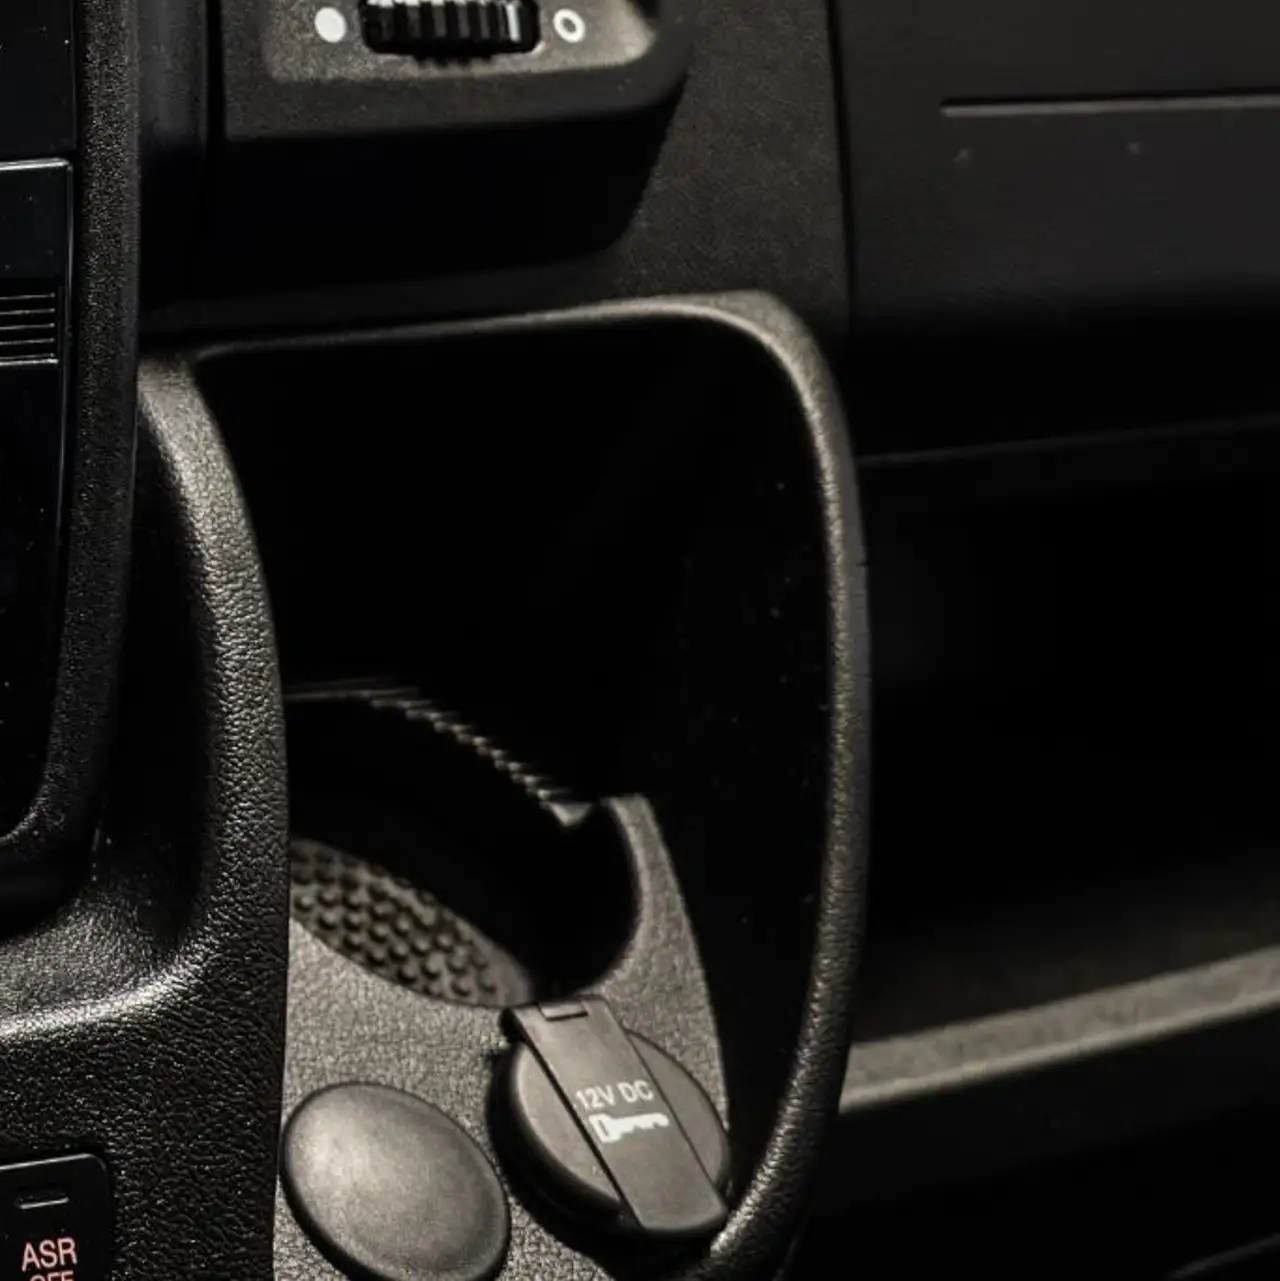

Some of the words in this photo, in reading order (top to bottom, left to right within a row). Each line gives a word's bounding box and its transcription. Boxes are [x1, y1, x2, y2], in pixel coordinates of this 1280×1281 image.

[575, 1085, 615, 1110] 12V
[617, 1080, 654, 1104] DC
[21, 1236, 78, 1273] ASR
